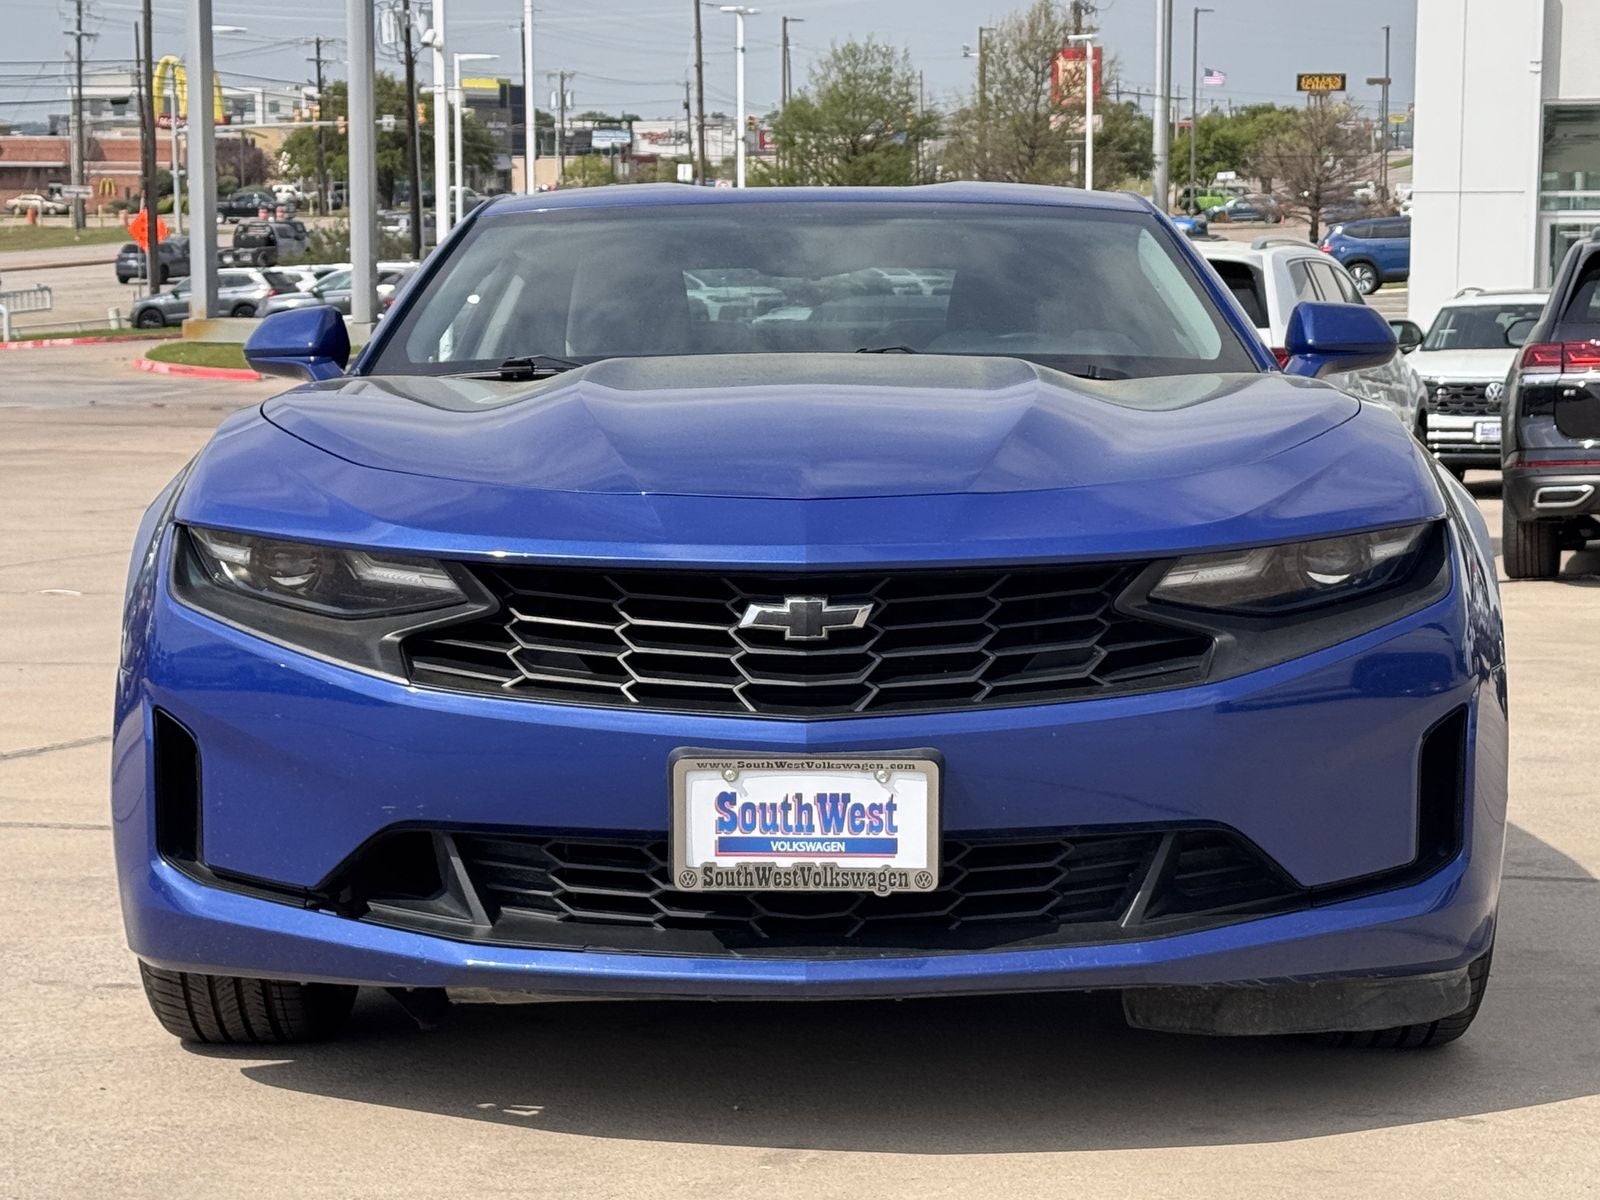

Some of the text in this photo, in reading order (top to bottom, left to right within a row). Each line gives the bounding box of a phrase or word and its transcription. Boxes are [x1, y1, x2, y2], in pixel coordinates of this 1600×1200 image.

[697, 760, 916, 771] www.SouthWestVolkswagen.com
[715, 791, 898, 835] SouthWest
[770, 840, 846, 852] VOLKSWAGEN
[702, 866, 909, 892] SouthWestVolkswagen
